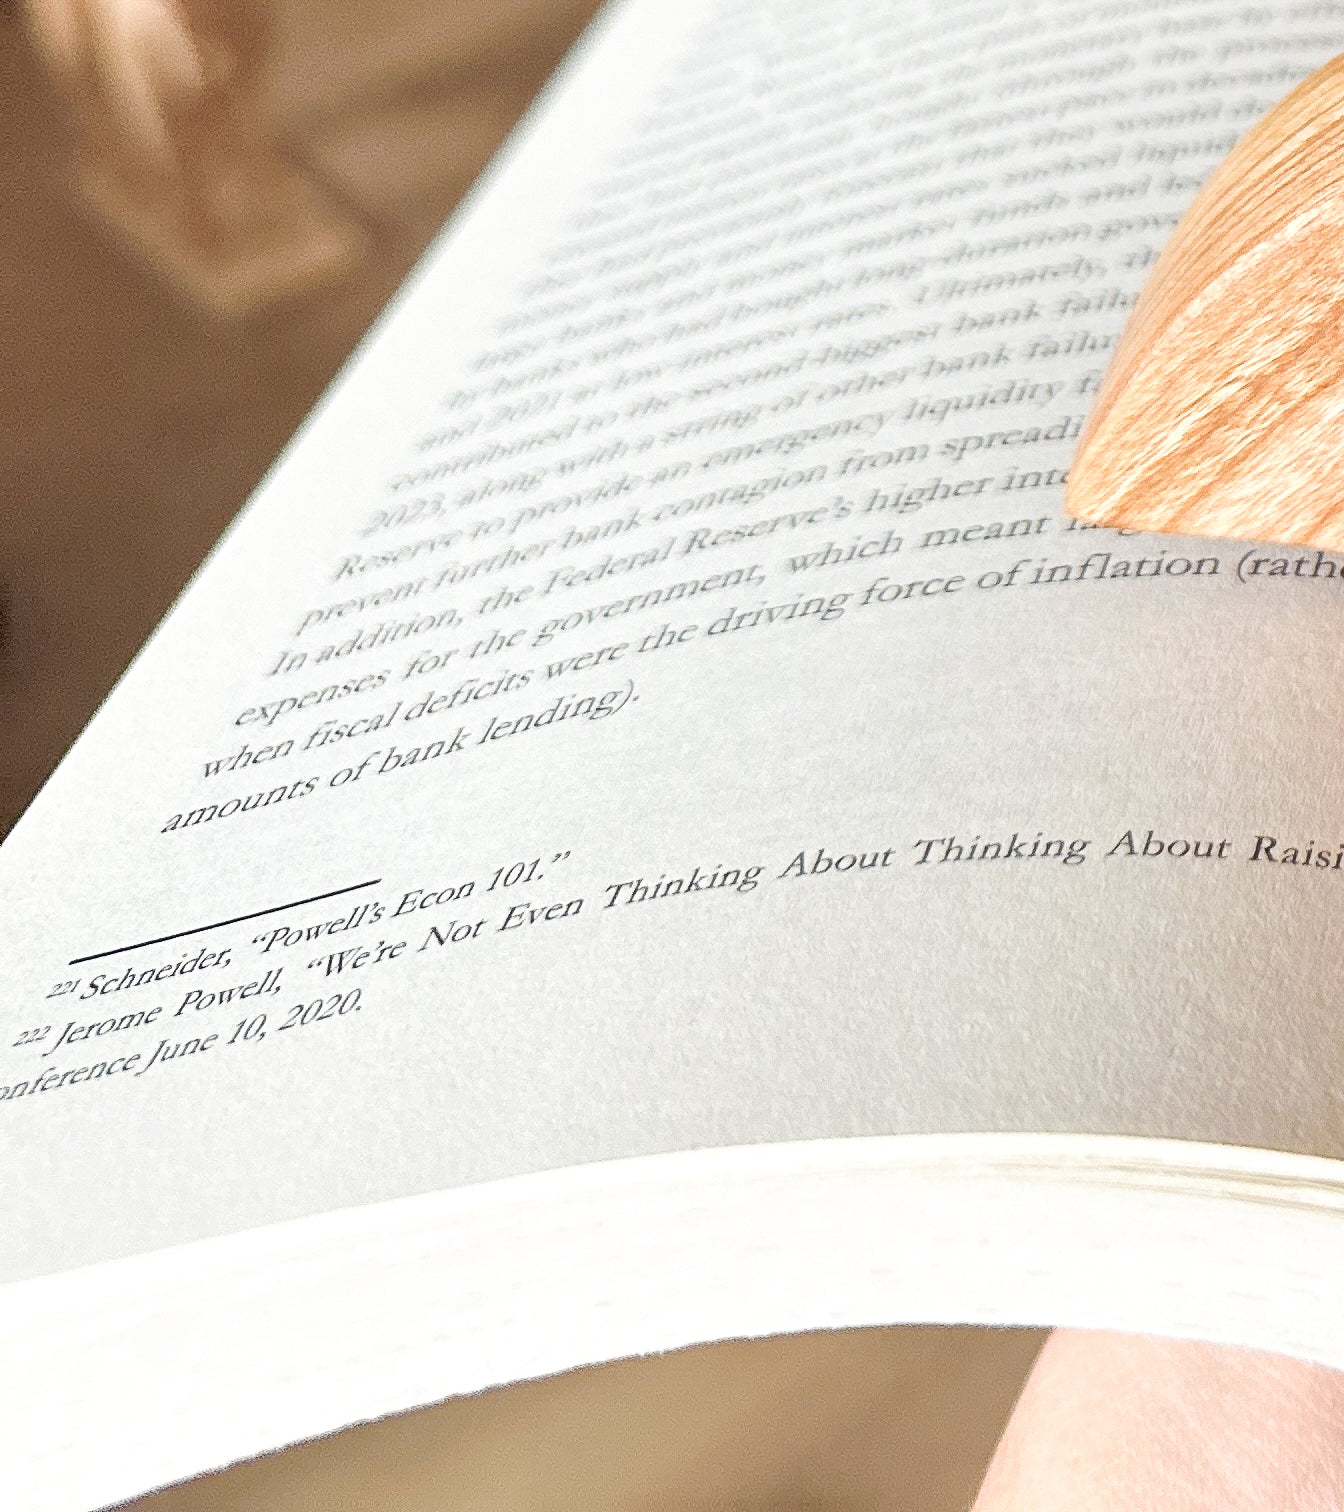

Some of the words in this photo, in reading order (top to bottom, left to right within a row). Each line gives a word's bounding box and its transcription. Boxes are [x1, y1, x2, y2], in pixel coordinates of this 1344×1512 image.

[265, 651, 308, 677] In
[314, 609, 463, 665] addition,
[476, 585, 534, 615] the
[539, 537, 677, 596] Federal
[861, 477, 995, 515] higher
[558, 507, 646, 551] bank
[649, 465, 828, 522] contagion
[834, 444, 930, 478] from
[204, 740, 294, 778] when
[301, 701, 403, 751] fiscal
[404, 670, 534, 722] deficits
[544, 643, 629, 680] were
[636, 624, 698, 653] the
[704, 593, 854, 637] driving
[859, 575, 966, 606] force
[974, 559, 1029, 590] of
[1028, 550, 1219, 585] inflation
[233, 670, 391, 727] expenses
[401, 649, 459, 681] for
[468, 629, 527, 659] the
[531, 564, 766, 648] government,
[785, 530, 904, 574] which
[916, 516, 1052, 550] meant
[160, 777, 320, 834] amounts
[329, 751, 381, 788] of
[371, 727, 470, 775] bank
[476, 679, 639, 745] lending).
[41, 1007, 163, 1058] Jerome
[174, 967, 283, 1017] Powell,
[307, 940, 407, 977] “We’re
[417, 919, 487, 952] Not
[496, 899, 584, 932] Even
[604, 864, 765, 909] Thinking
[777, 848, 895, 879] About
[913, 832, 1091, 866] Thinking
[1105, 830, 1232, 859] About
[79, 948, 231, 1000] Schneider,
[252, 902, 385, 953] “Powell’s
[390, 881, 475, 918] Econ
[486, 850, 571, 892] 101.”
[0, 1053, 150, 1101] onference
[135, 1034, 219, 1077] June
[227, 1014, 267, 1045] 10,
[277, 988, 362, 1031] 2020.
